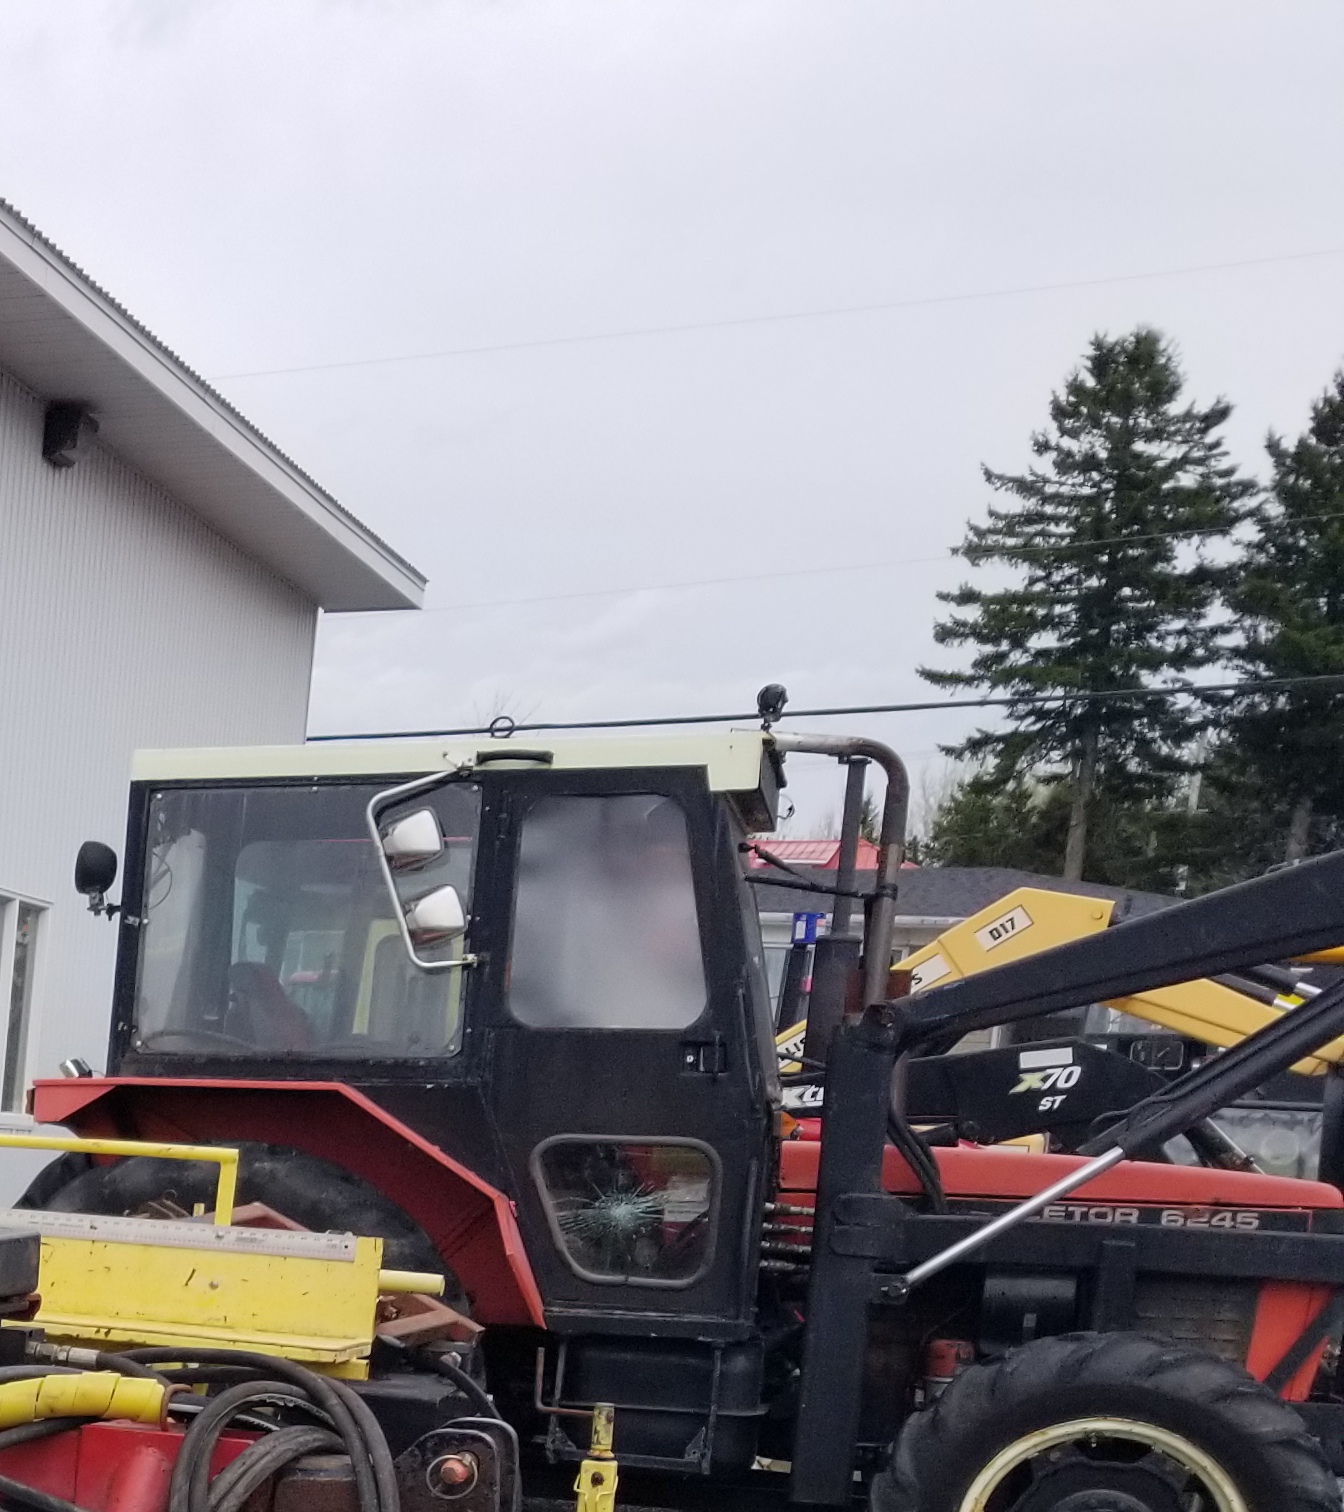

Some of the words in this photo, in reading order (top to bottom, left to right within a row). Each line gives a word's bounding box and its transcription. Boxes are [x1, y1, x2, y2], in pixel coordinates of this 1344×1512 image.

[1009, 1066, 1082, 1095] X70
[1038, 1095, 1067, 1111] ST
[1024, 1205, 1140, 1224] ETOR
